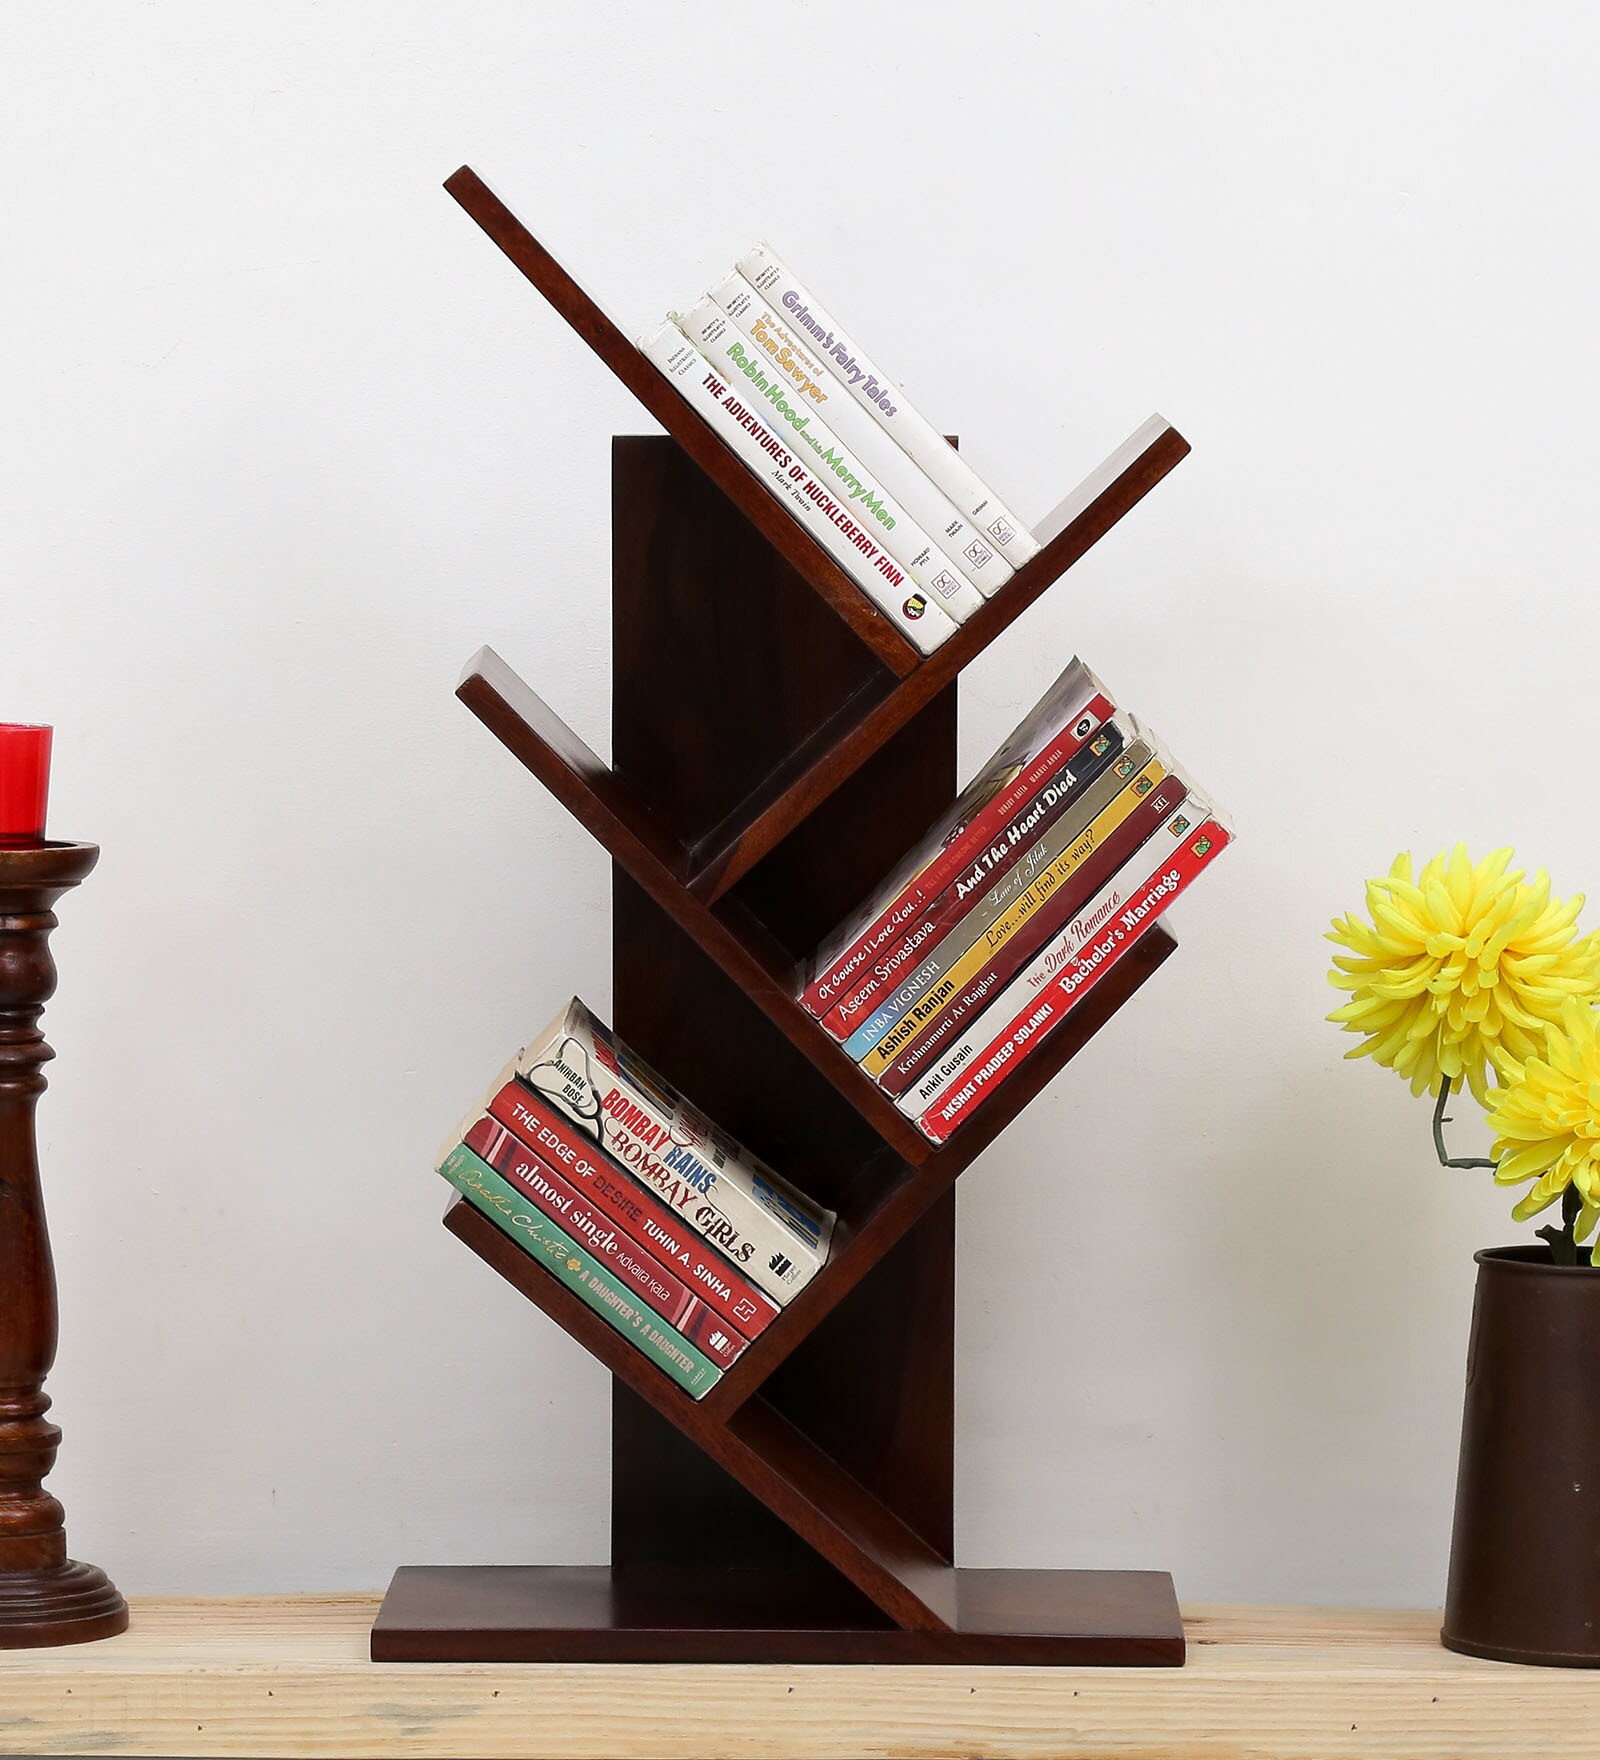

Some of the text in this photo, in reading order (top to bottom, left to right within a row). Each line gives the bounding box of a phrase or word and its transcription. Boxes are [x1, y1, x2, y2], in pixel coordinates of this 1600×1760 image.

[750, 318, 828, 404] Tom Sawyer
[761, 312, 776, 329] The
[812, 366, 825, 377] of
[782, 290, 897, 417] Grimm's Fairy Tales
[701, 372, 905, 587] THE ADVENTURES OF HUCKLEBERRY FINN
[726, 342, 769, 391] Robin
[764, 384, 810, 431] Hood
[820, 446, 867, 499] Merry
[860, 490, 897, 531] Men
[771, 470, 812, 512] Mark Twain
[956, 768, 1078, 900] And The Heart Died
[1152, 795, 1170, 812] KFI
[1012, 867, 1025, 888] of
[1034, 871, 1057, 902] find
[1071, 828, 1096, 862] way?
[832, 951, 867, 987] Course
[863, 944, 873, 955] I
[868, 924, 895, 949] Love
[837, 920, 936, 1022] Aseem Srivastava
[1026, 890, 1122, 989] The Dark Romance
[1057, 867, 1182, 995] Bachelor's Marriage
[861, 961, 941, 1042] INBA VIGNESH
[876, 978, 955, 1060] Ashish Ranjan
[897, 971, 999, 1075] Krishnamurti At Rajghat
[553, 1059, 588, 1091] ANIRBAN
[562, 1083, 585, 1105] BOSE
[918, 1043, 974, 1100] Ankit Gusain
[940, 1002, 1055, 1121] AKSHAT PRADEEP SOLANKI
[511, 1103, 644, 1222] THE EDGE OF DESIRE
[601, 1087, 717, 1194] BOMBAY RAINS
[608, 1124, 698, 1210] BOMBAY
[511, 1214, 569, 1259] Christie
[515, 1162, 574, 1214] almost
[569, 1210, 619, 1255] single
[616, 1252, 671, 1301] Advaita Kala
[641, 1218, 733, 1302] TUHIN A. SINHA
[578, 1270, 696, 1374] A DAUGHTER'S A DAUGHTER
